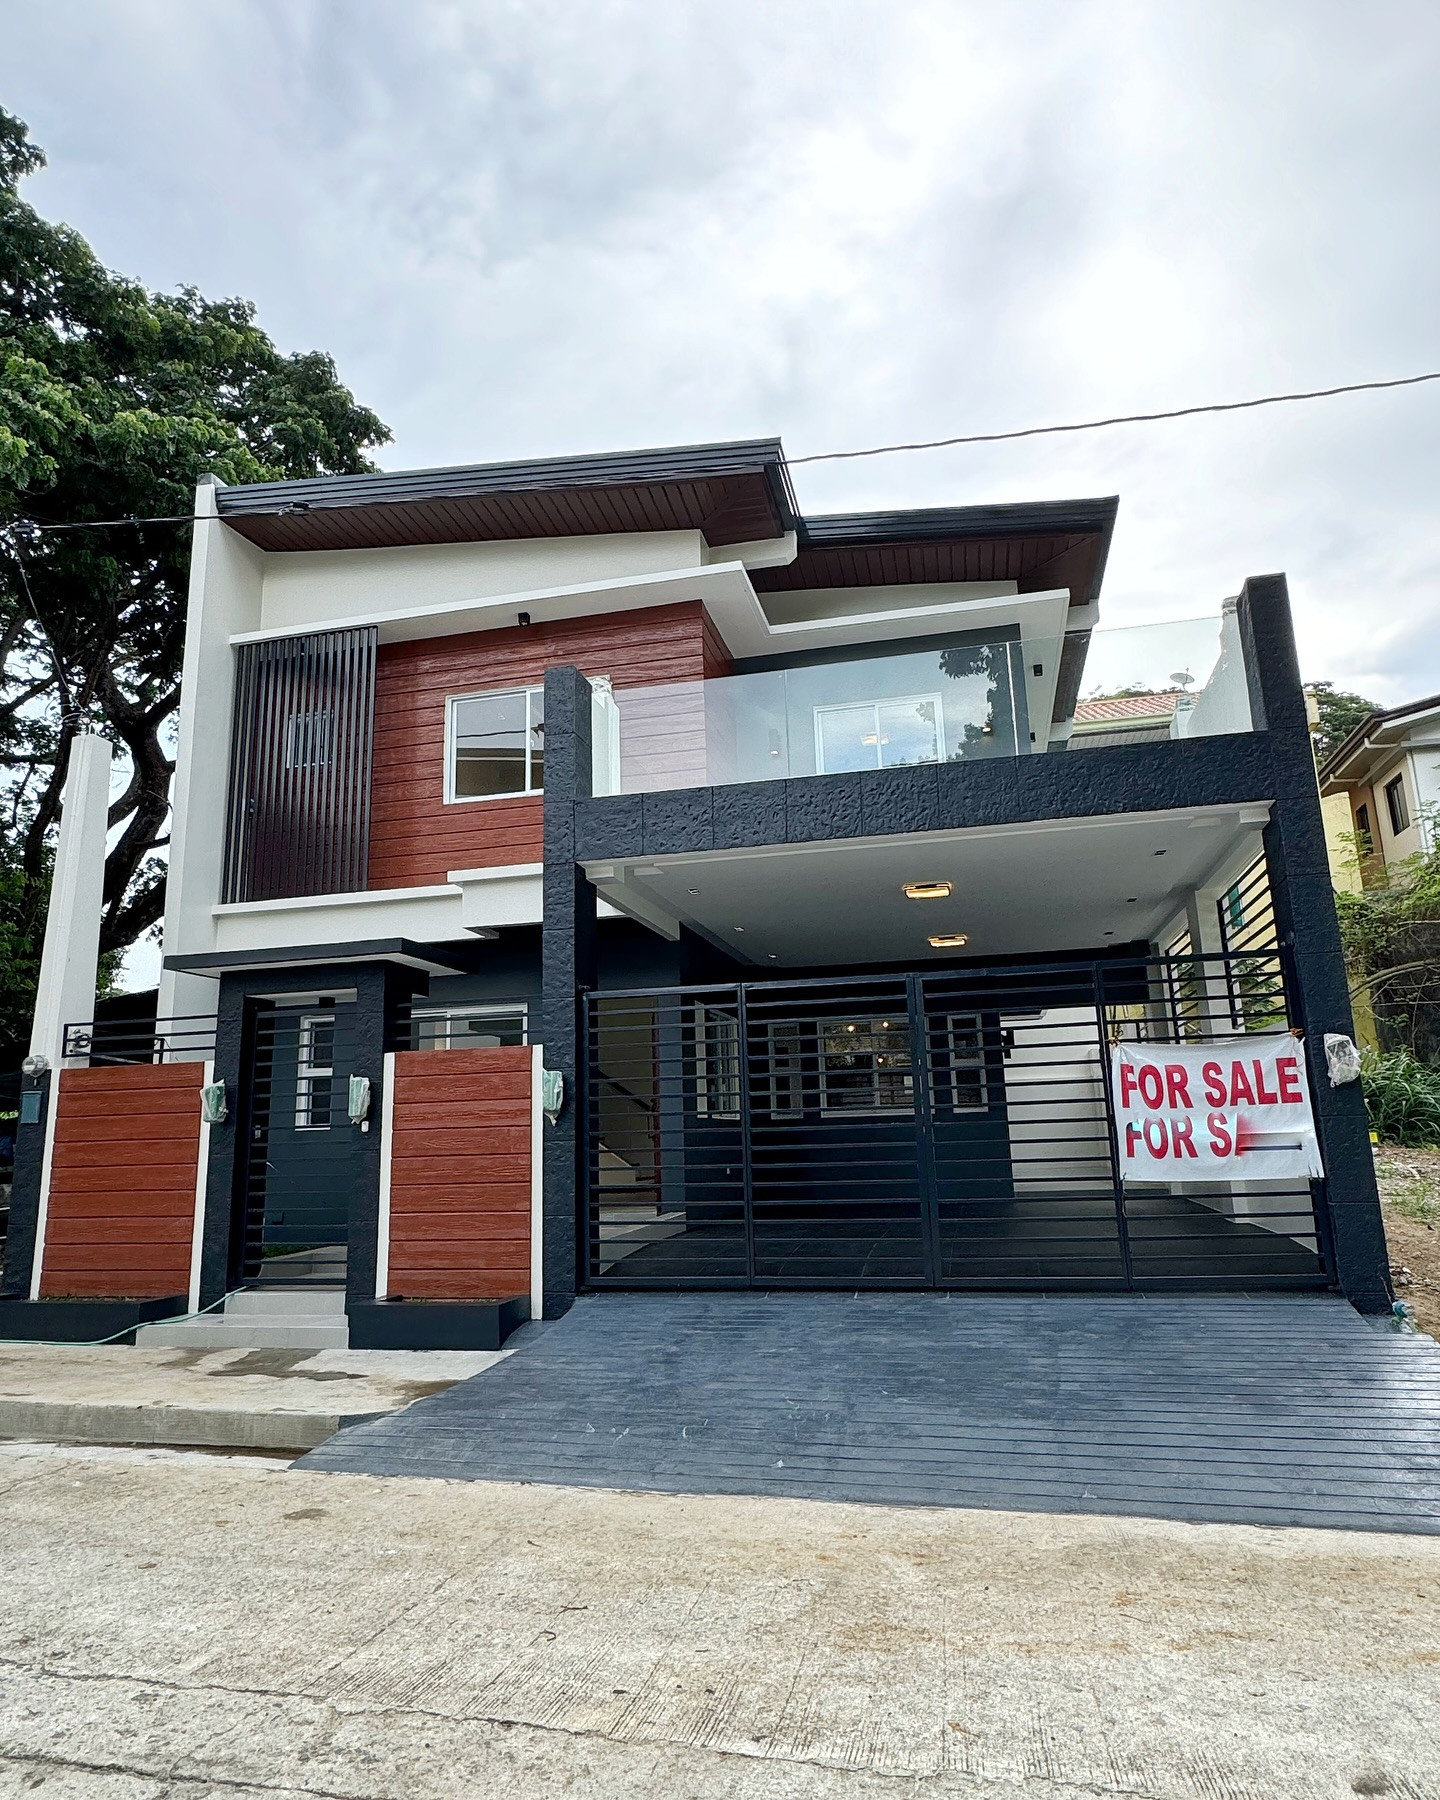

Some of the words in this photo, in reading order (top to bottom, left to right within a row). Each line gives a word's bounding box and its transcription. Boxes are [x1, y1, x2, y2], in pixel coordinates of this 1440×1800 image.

[1120, 1063, 1194, 1110] FOR
[1202, 1056, 1303, 1108] SALE
[1126, 1114, 1198, 1160] FOR
